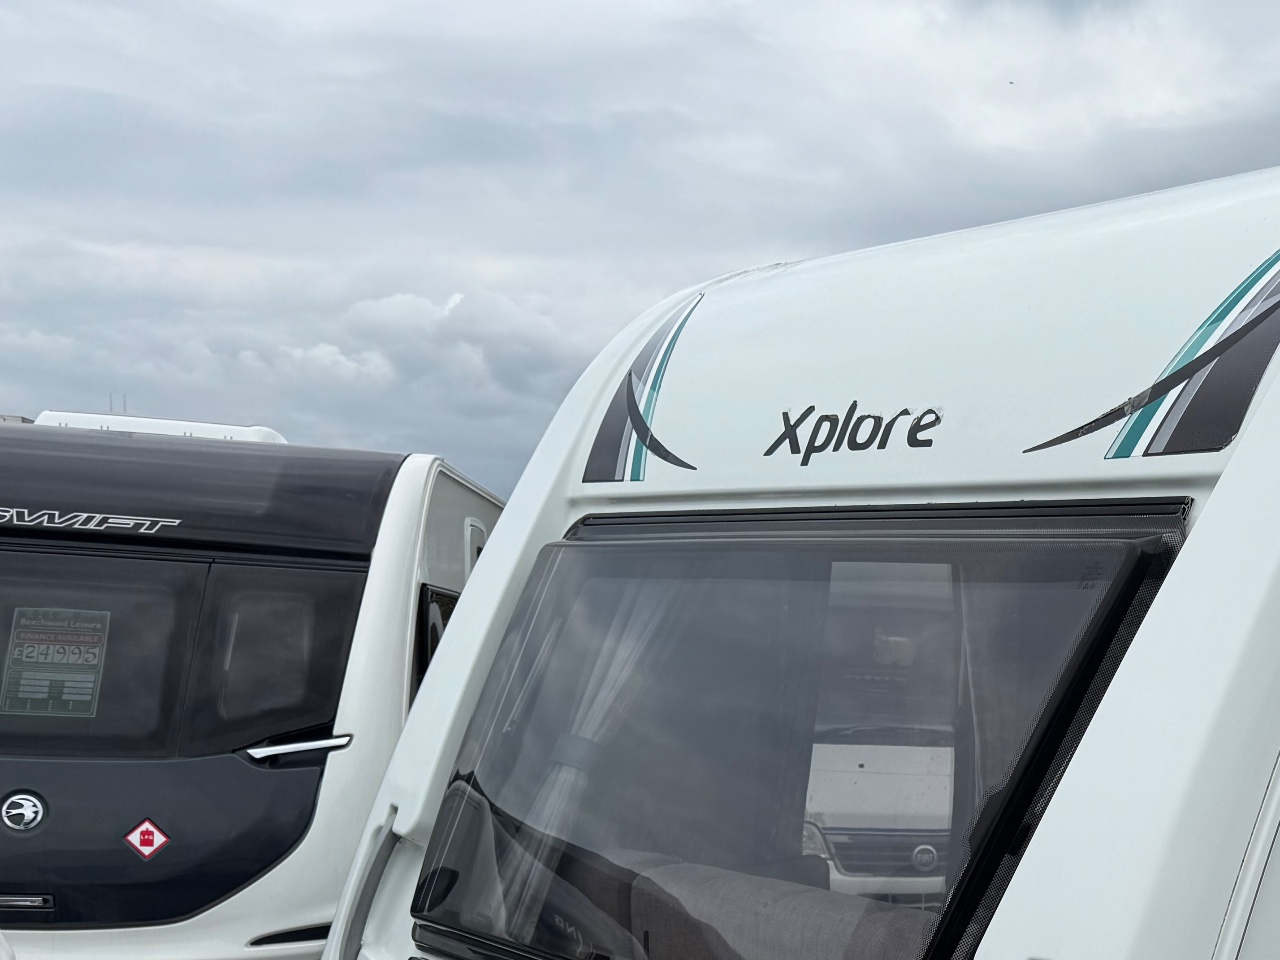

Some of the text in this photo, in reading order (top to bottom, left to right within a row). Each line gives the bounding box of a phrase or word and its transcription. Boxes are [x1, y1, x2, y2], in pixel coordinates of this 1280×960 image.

[763, 400, 942, 466] Xplore
[20, 633, 99, 643] FINANCE AVAILABLE
